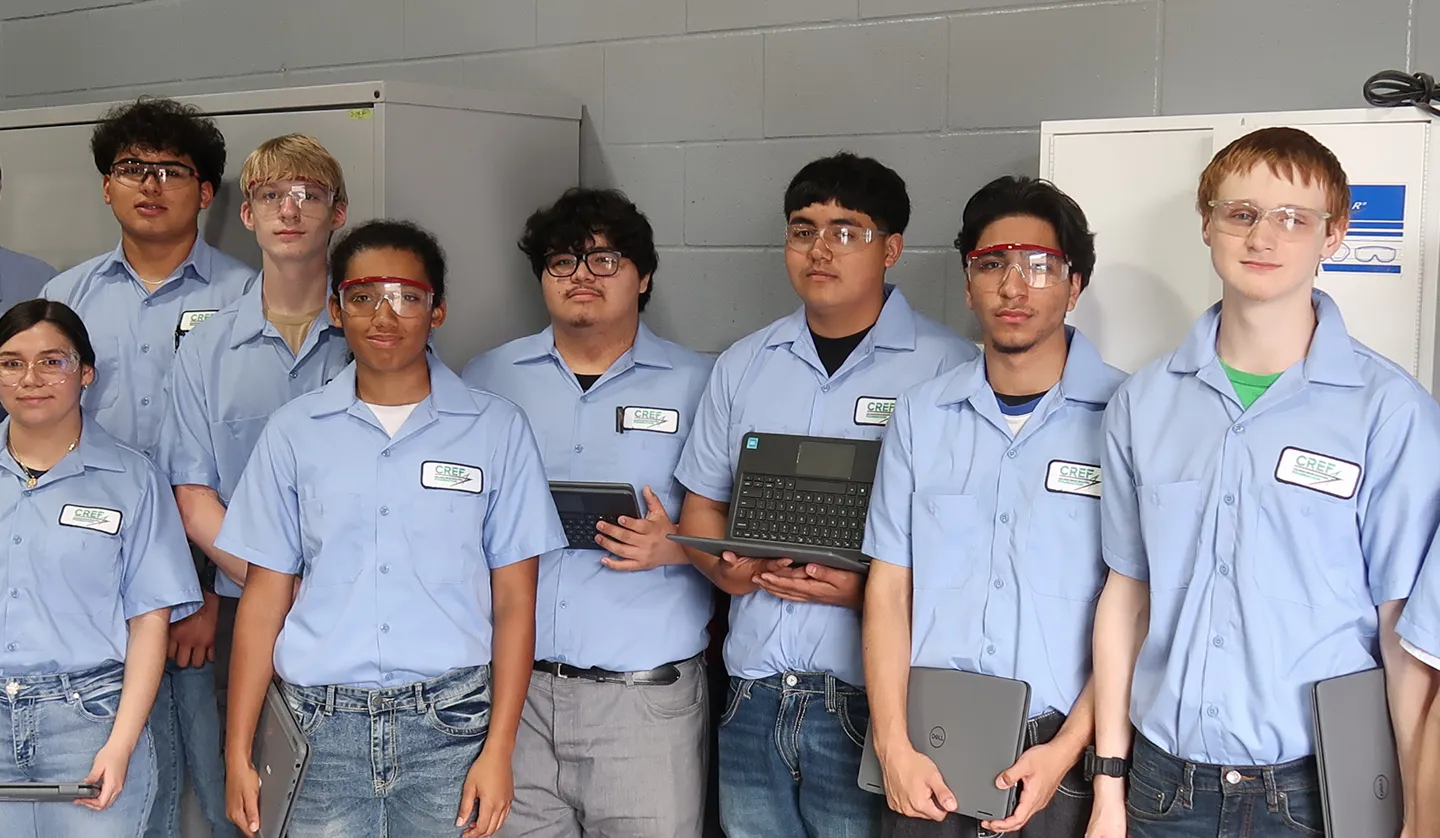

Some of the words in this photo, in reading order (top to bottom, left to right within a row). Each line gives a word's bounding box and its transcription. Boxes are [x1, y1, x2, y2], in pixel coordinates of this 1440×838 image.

[634, 409, 662, 420] CREF
[1296, 455, 1336, 473] CREF
[435, 465, 466, 477] CREF
[1060, 465, 1095, 479] CREF
[74, 508, 105, 519] CREF
